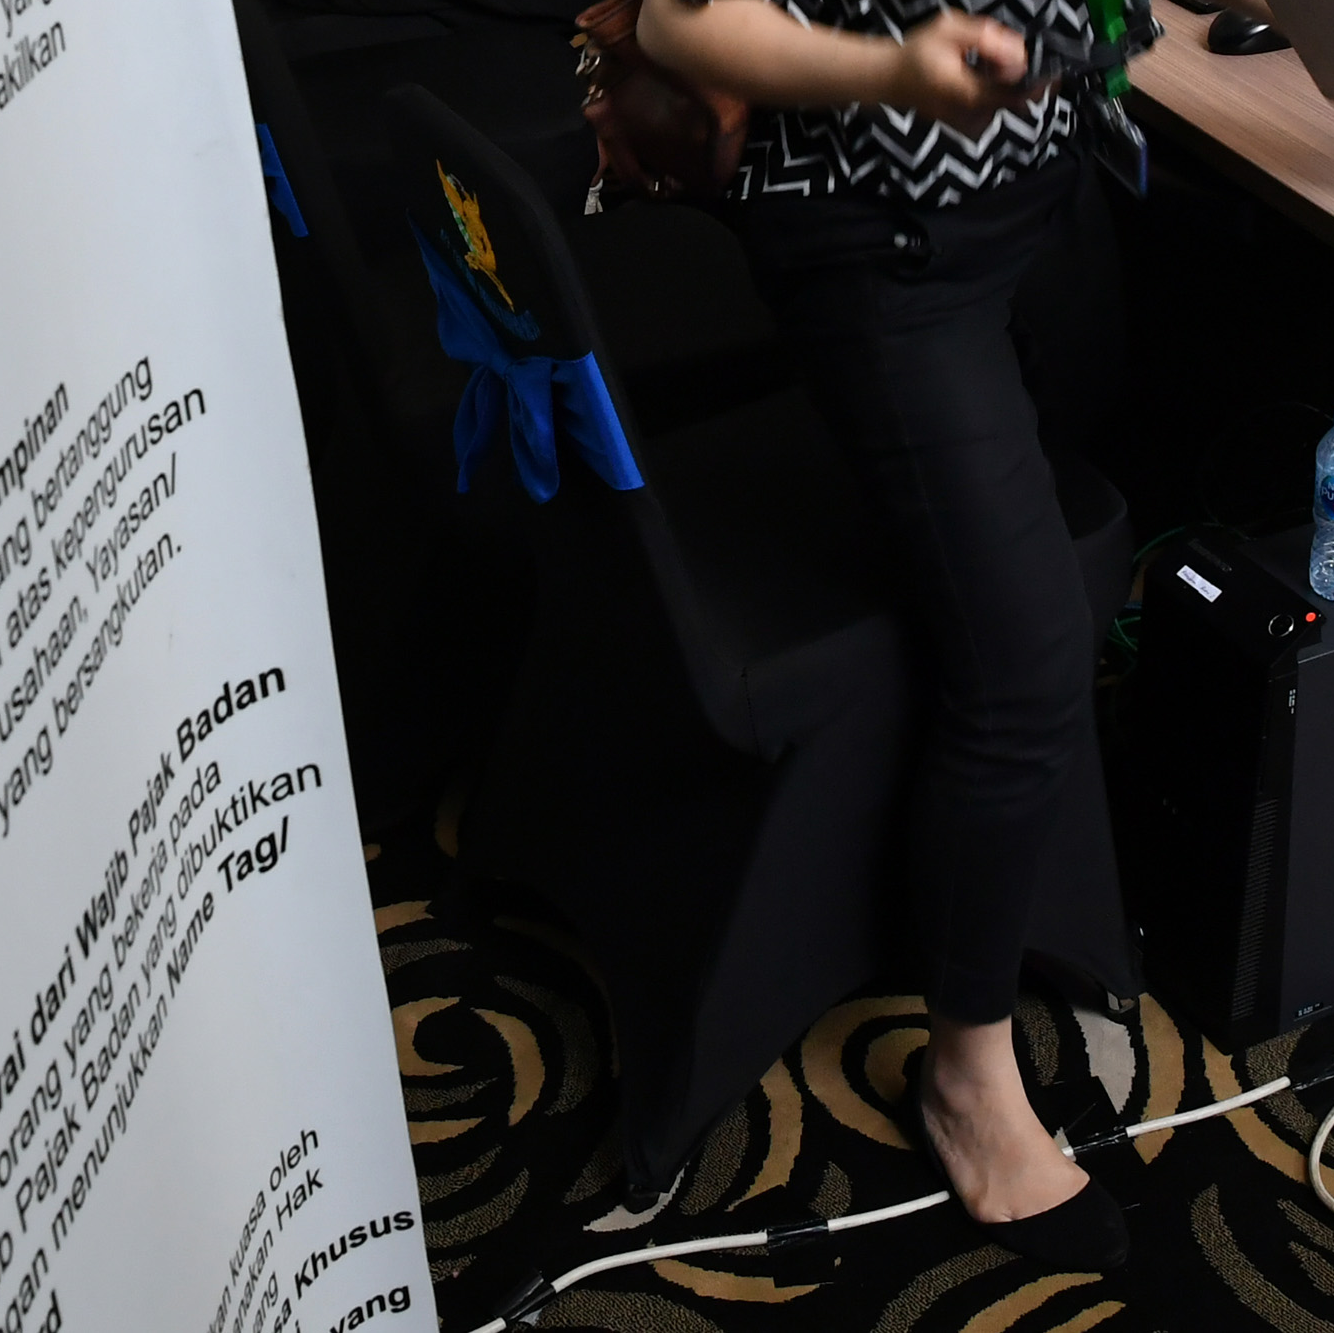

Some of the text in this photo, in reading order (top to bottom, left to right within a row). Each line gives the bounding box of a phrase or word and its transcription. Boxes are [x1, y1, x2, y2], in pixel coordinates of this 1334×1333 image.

[7, 567, 51, 648] atas
[52, 389, 205, 578] kepengurusan
[32, 357, 152, 530] bertanggung
[86, 453, 175, 592] Yayasan/
[53, 534, 180, 737] bersangkutan.
[31, 945, 75, 1045] dari
[76, 851, 128, 959] Wajib
[129, 753, 174, 857] Pajak
[177, 668, 285, 763] Badan
[64, 964, 113, 1078] yang
[113, 840, 167, 971] bekerja
[170, 762, 220, 855] pada
[16, 1105, 80, 1233] Pajak
[82, 983, 140, 1111] Badan
[142, 895, 176, 997] yang
[179, 764, 321, 899] dibuktikan
[52, 994, 166, 1250] menunjukkan
[167, 893, 213, 998] Name
[218, 816, 288, 892] Tag/
[230, 1131, 317, 1286] kuasa oleh
[277, 1169, 322, 1231] Hak
[295, 1212, 414, 1299] Khusus
